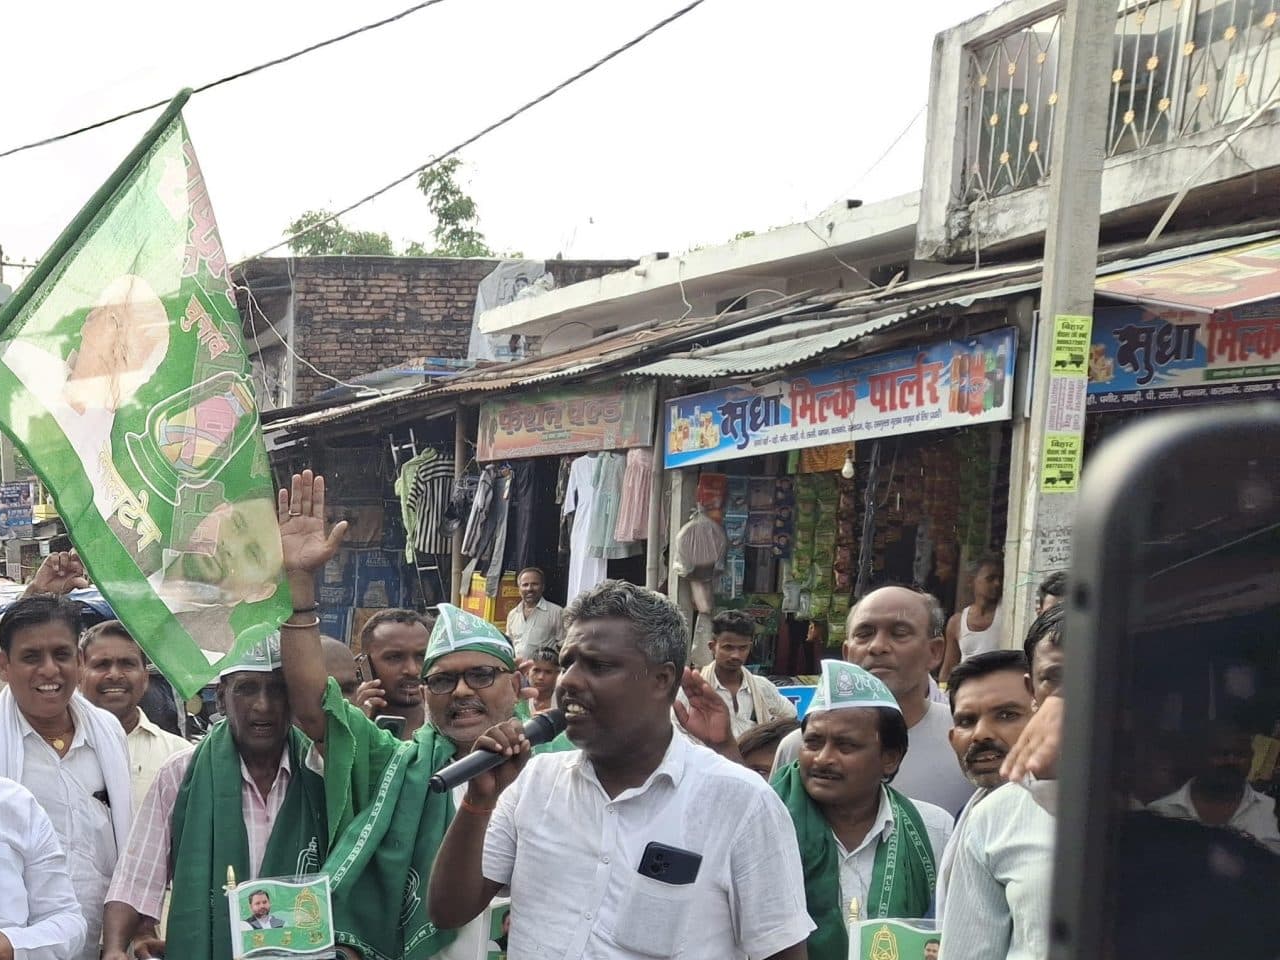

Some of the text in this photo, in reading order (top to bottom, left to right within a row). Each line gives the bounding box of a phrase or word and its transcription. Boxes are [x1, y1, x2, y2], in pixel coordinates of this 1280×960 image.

[1112, 323, 1201, 386] सुधा
[717, 393, 784, 450] सुधा
[788, 377, 859, 428] मिल्क
[868, 351, 945, 413] पार्लर
